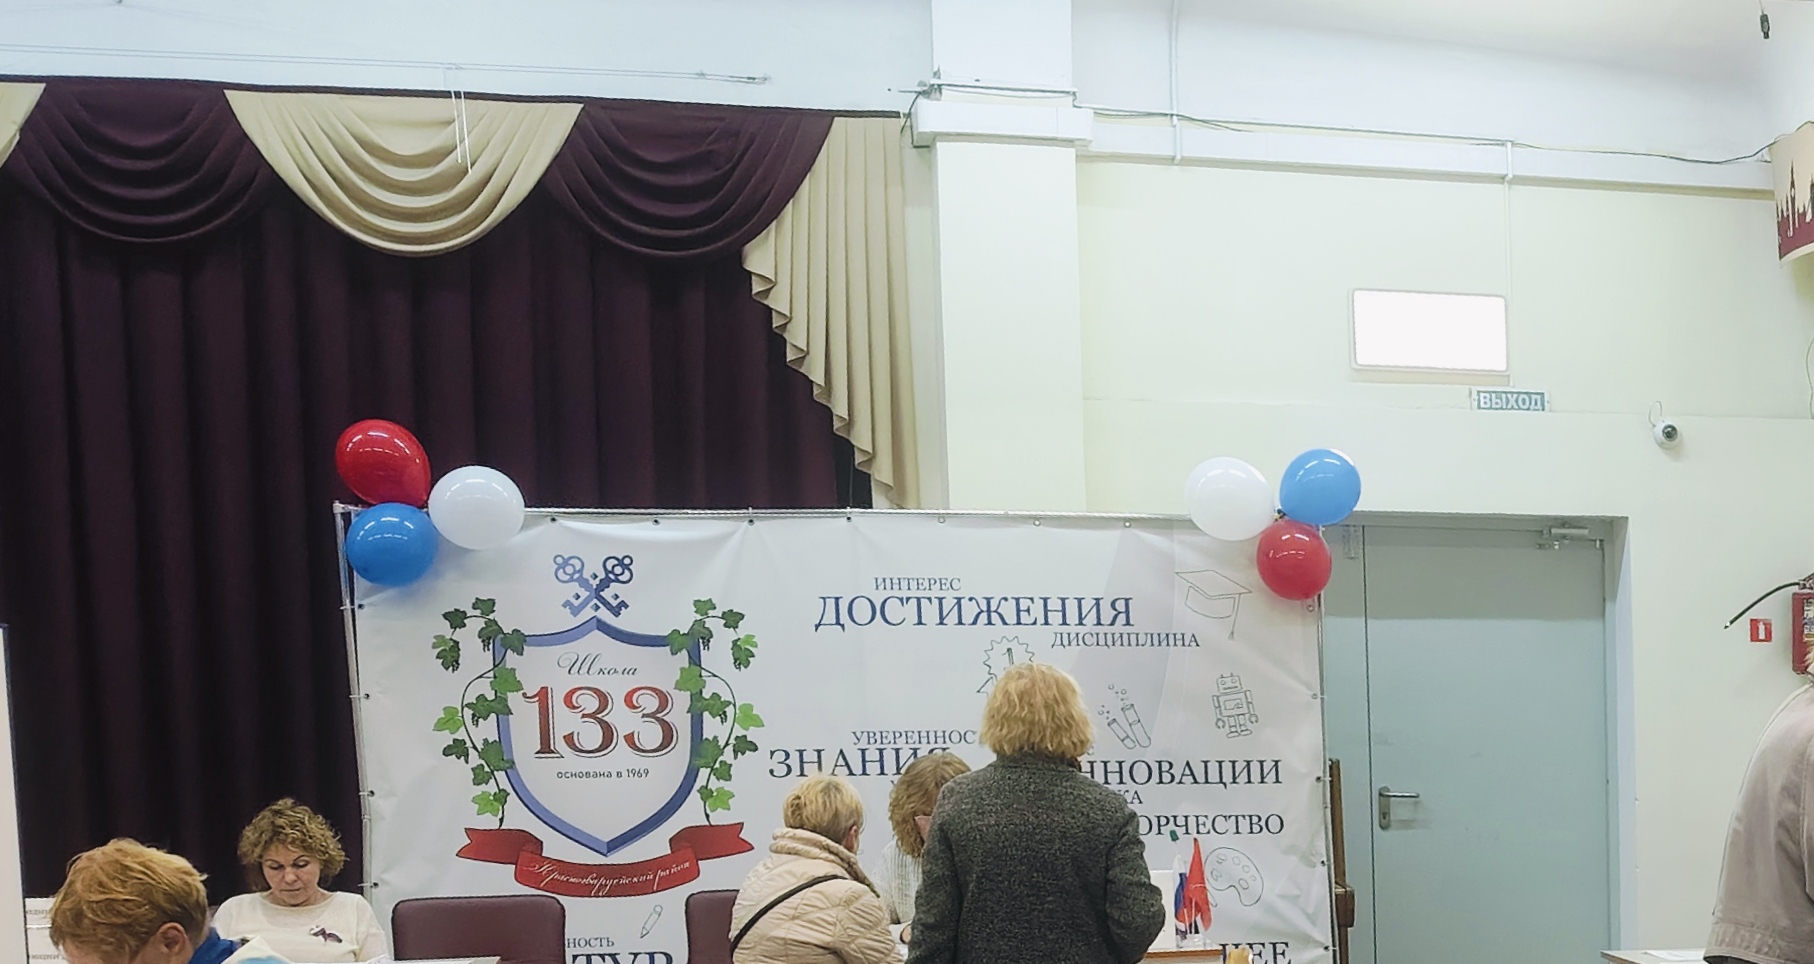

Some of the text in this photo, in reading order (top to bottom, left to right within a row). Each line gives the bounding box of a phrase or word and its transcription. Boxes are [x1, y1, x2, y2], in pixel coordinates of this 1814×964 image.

[1479, 392, 1543, 411] ВЫХОД
[873, 577, 962, 592] ИНТЕРЕС
[814, 595, 1135, 632] ДОСТИЖЕНИЯ
[1051, 632, 1201, 650] ДИСЦИПЛИНА
[556, 651, 638, 676] Школа
[521, 685, 679, 759] 133
[851, 729, 978, 746] УВЕРЕННОС
[768, 747, 950, 778] ЗНАНИ
[556, 768, 650, 779] основана в 1969
[1080, 759, 1283, 789] ННОВАЦИИ
[1139, 813, 1285, 836] ОРЧЕСТВО
[567, 936, 615, 948] НОСТЬ
